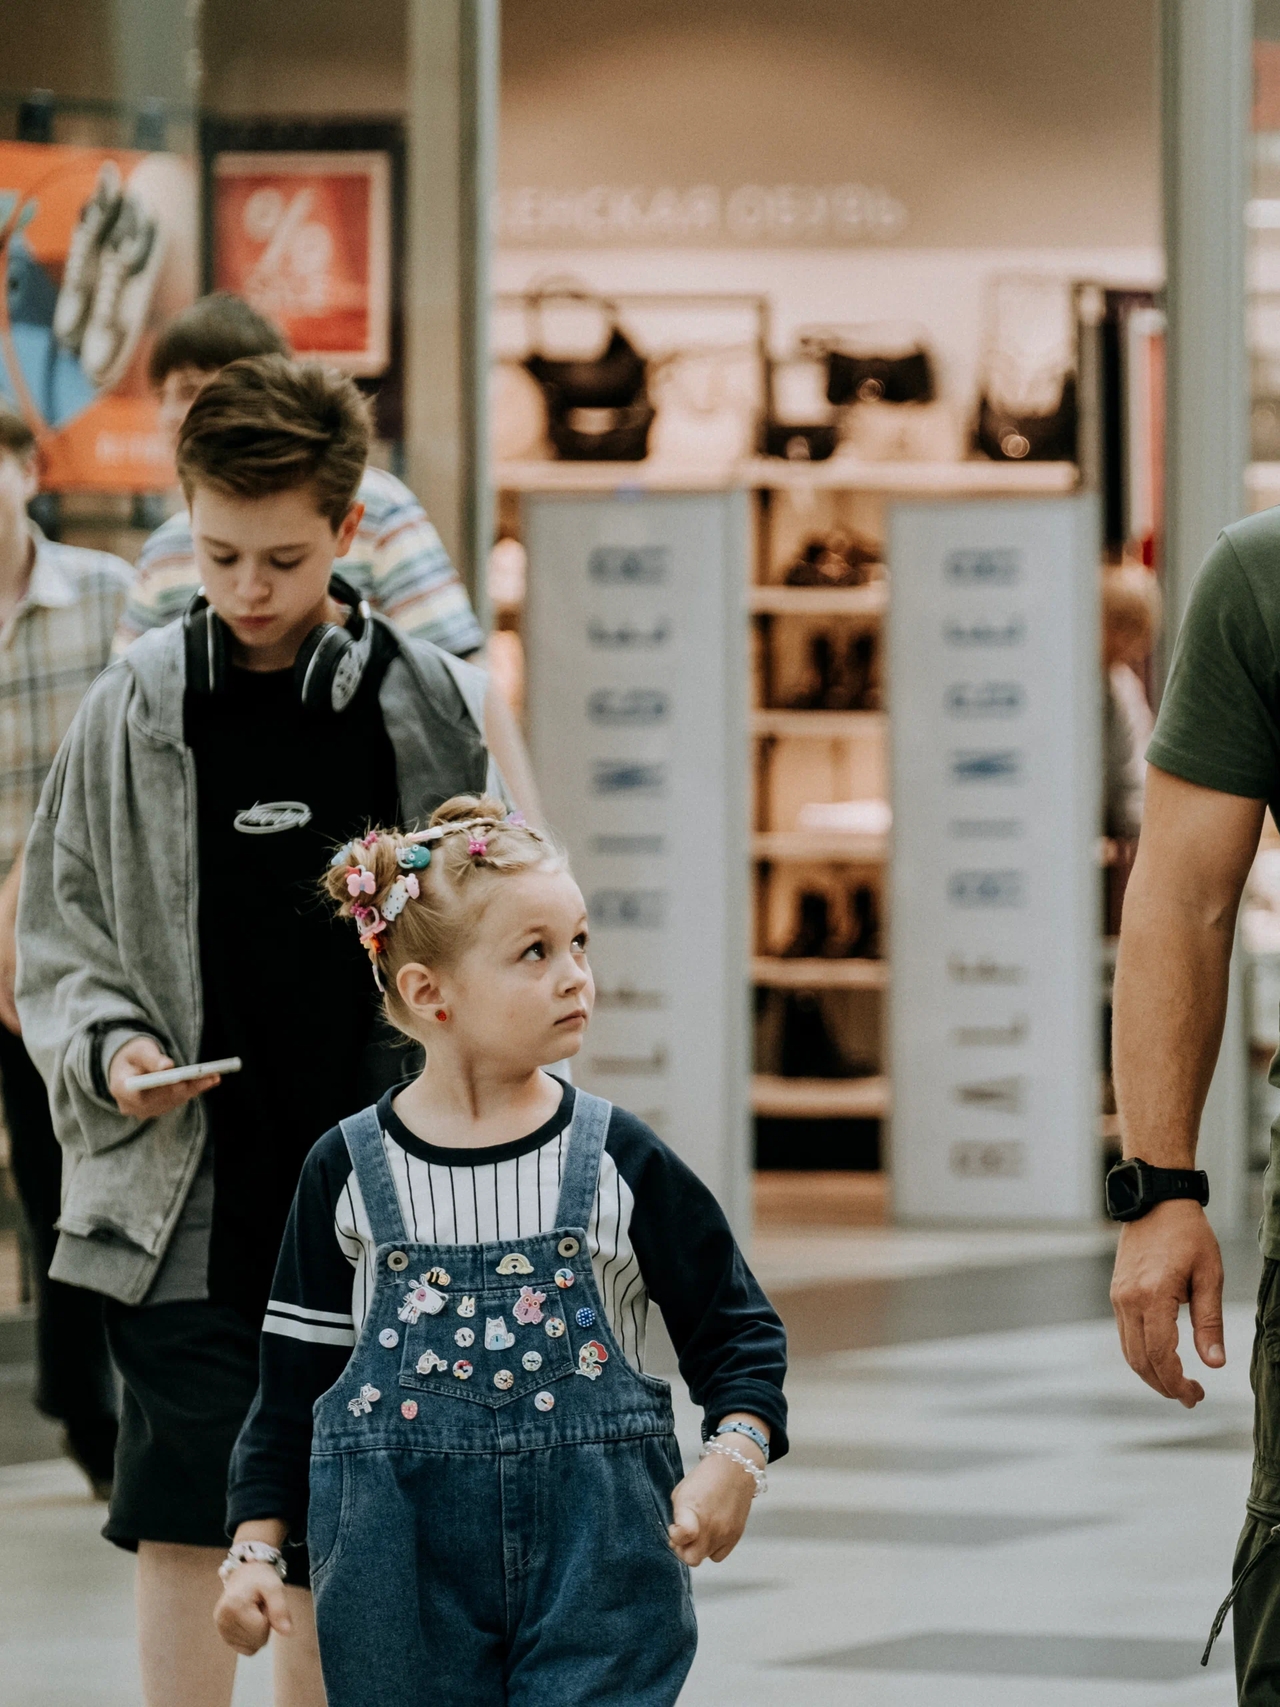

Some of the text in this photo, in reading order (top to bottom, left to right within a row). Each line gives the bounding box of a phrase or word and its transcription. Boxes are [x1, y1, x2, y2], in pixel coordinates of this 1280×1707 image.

[587, 544, 669, 928] RINGER
[943, 545, 1025, 1179] RALF RINGER
